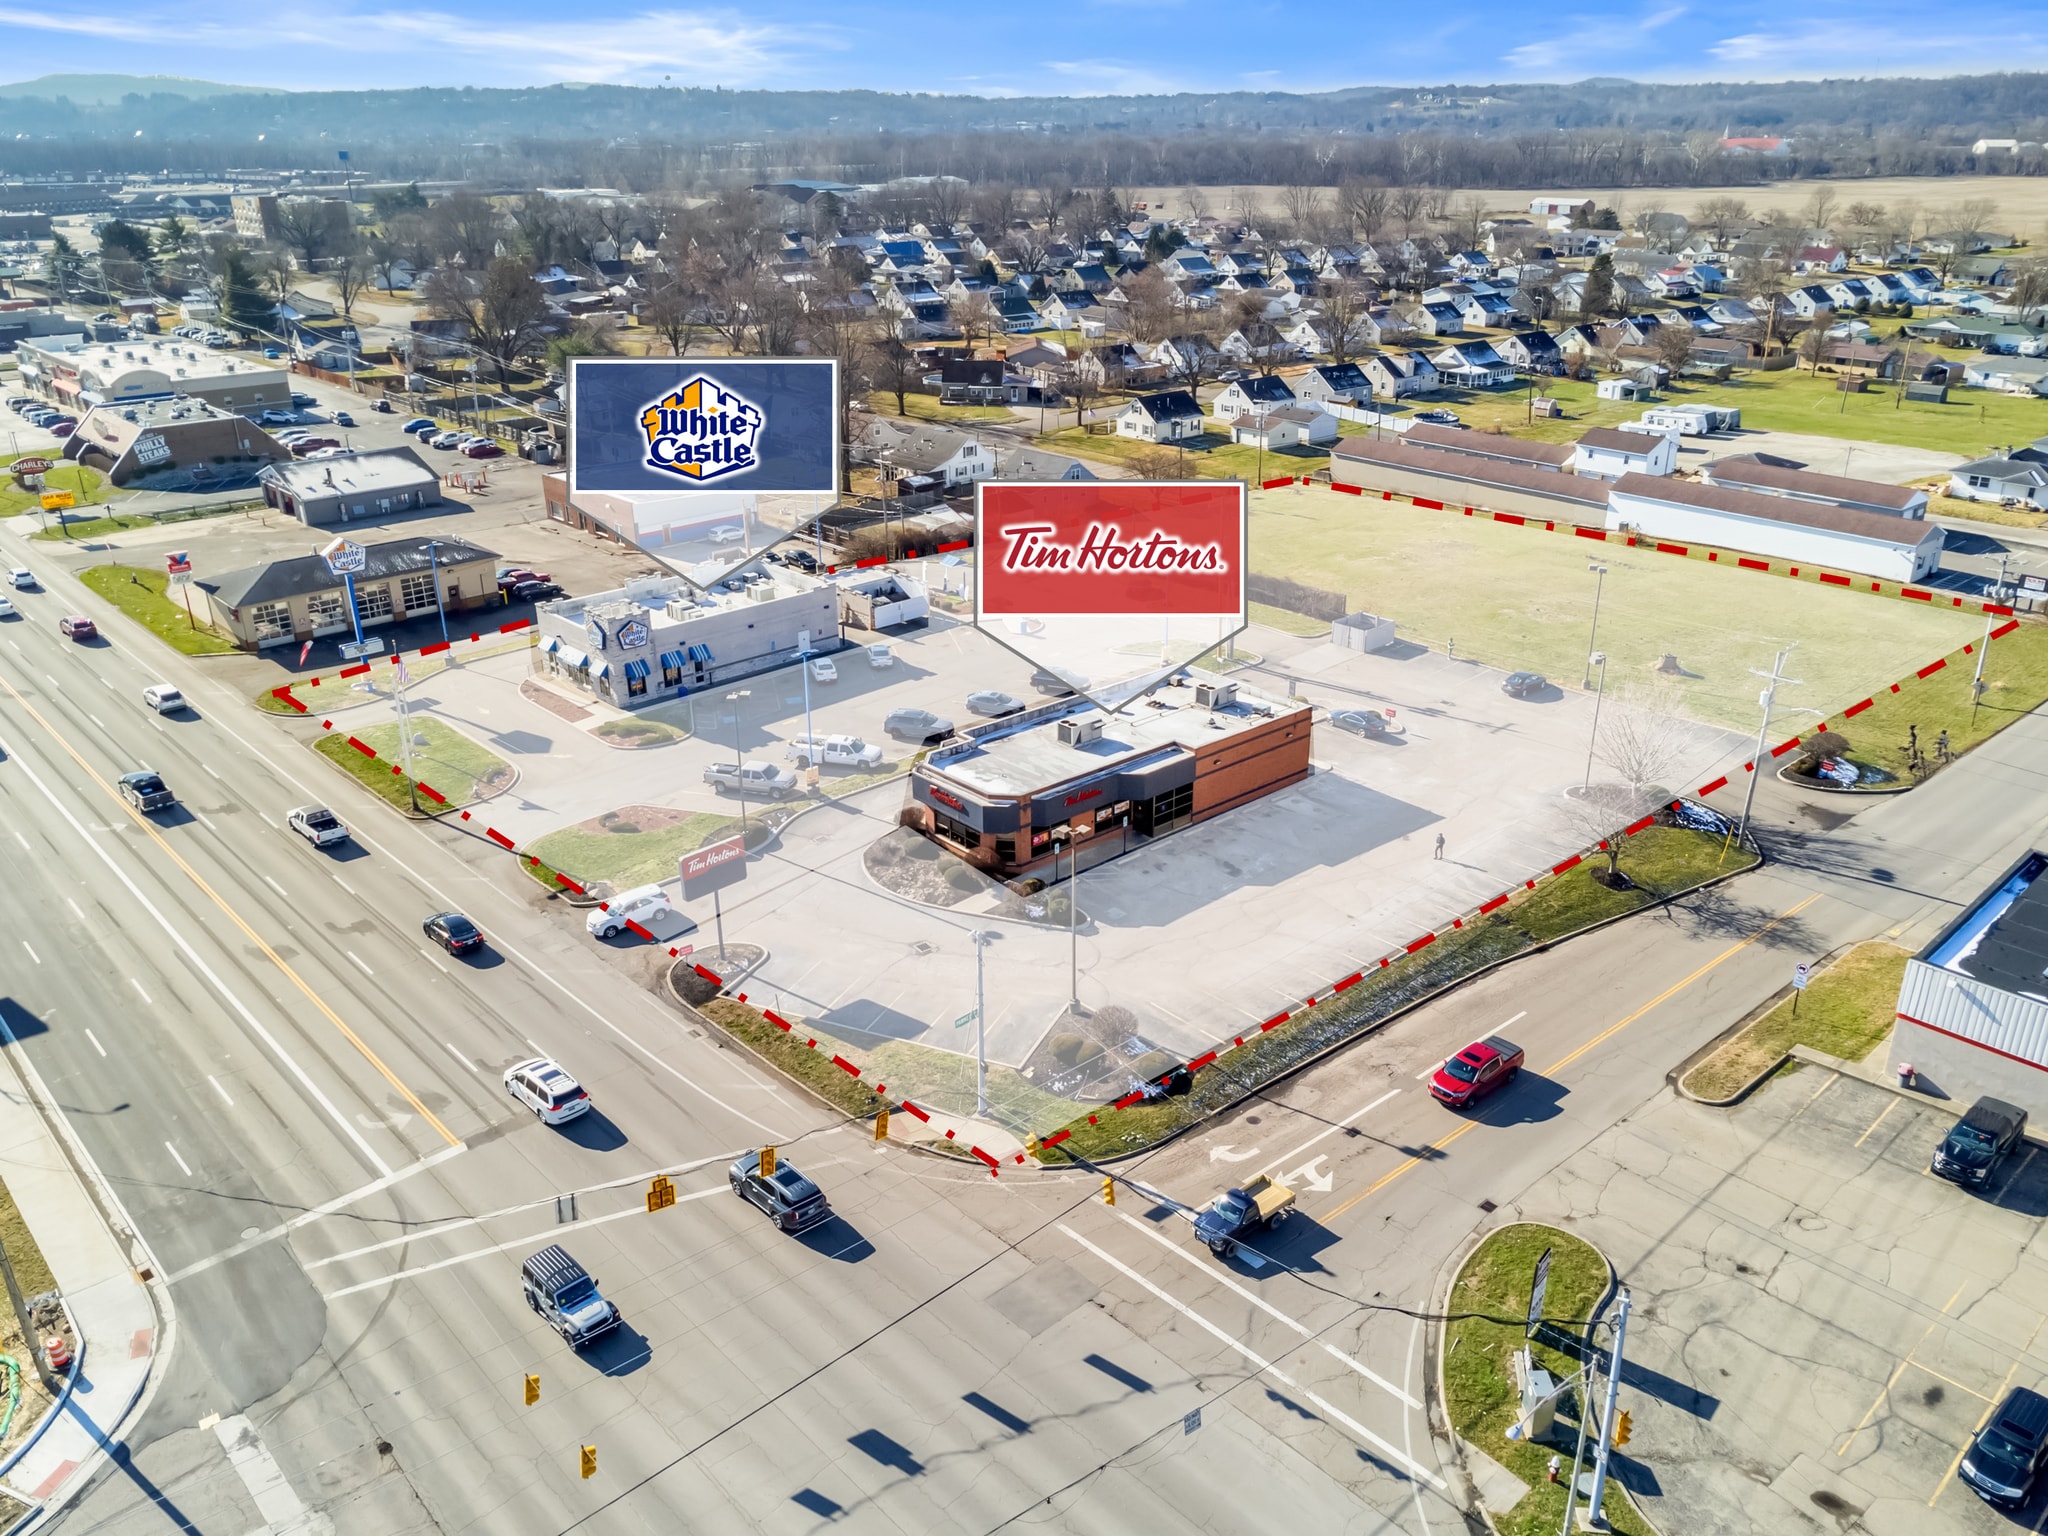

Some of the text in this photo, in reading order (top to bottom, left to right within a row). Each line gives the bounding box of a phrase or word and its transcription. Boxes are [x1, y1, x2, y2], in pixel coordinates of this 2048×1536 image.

[133, 436, 166, 455] PHILLY
[137, 445, 171, 462] STEAKS
[11, 460, 53, 472] CHARLEYS
[333, 550, 360, 560] White
[333, 557, 362, 568] Castle
[687, 847, 740, 874] Tim Hortons
